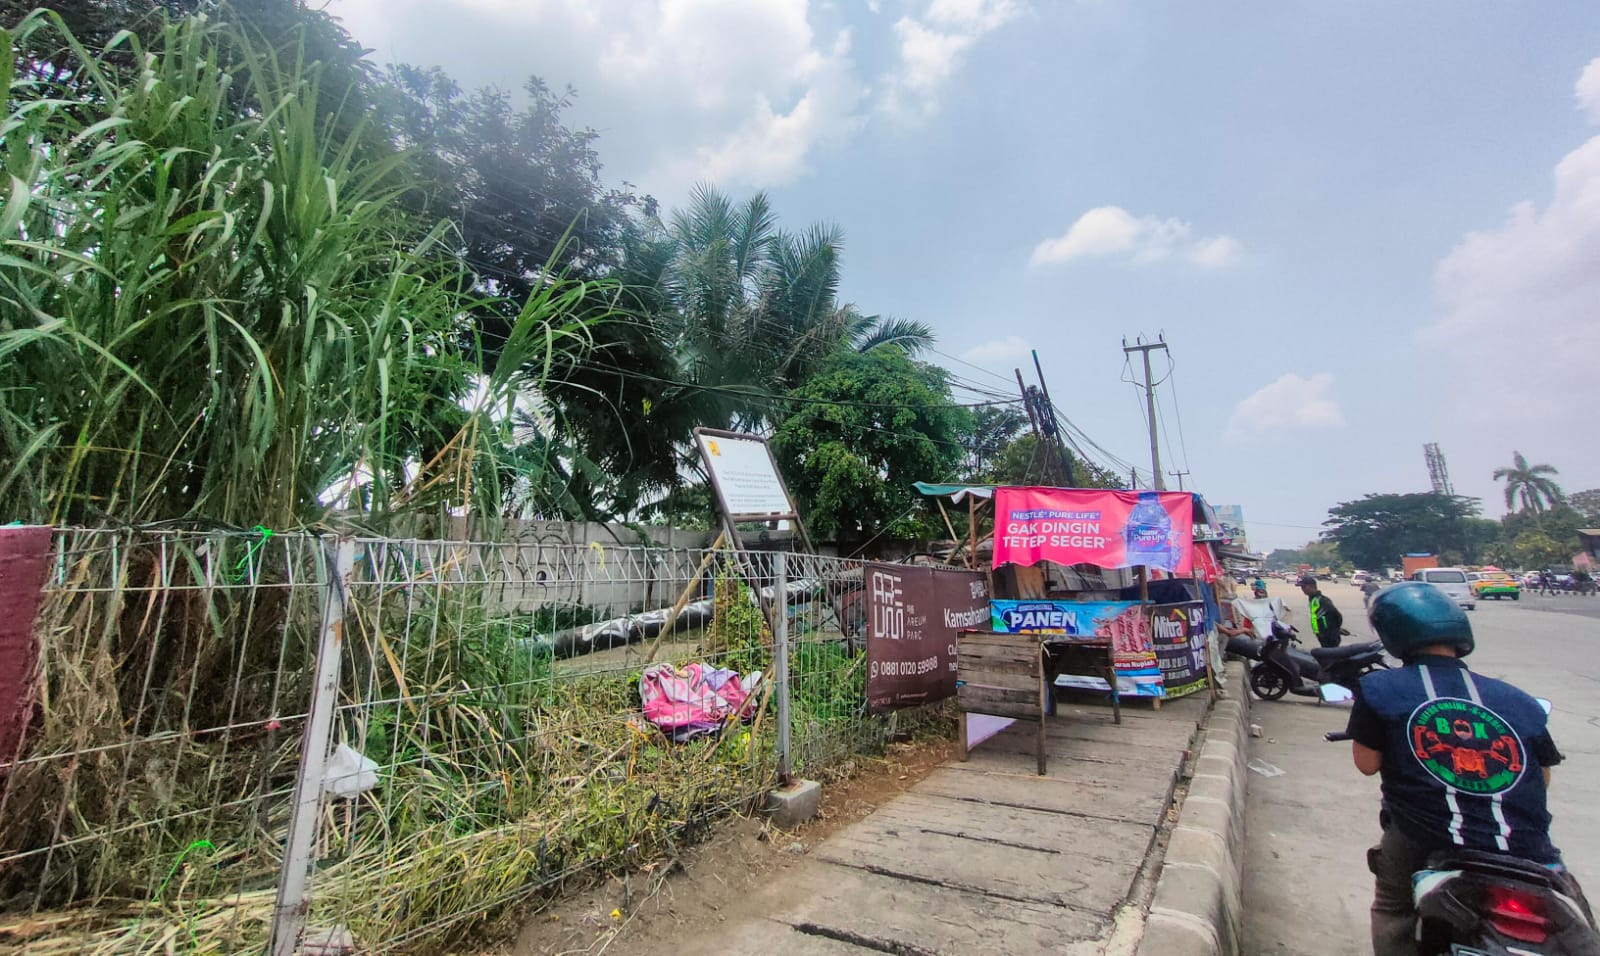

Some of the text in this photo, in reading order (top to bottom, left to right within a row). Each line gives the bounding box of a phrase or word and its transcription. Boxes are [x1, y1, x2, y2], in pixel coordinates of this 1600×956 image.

[1048, 511, 1074, 519] PURE
[1007, 522, 1100, 535] GAK DINGIN
[1002, 535, 1047, 549] TETEP
[1010, 611, 1077, 628] PANEN
[1154, 615, 1184, 639] Mitra
[880, 661, 899, 676] 0881
[900, 661, 917, 676] 0120
